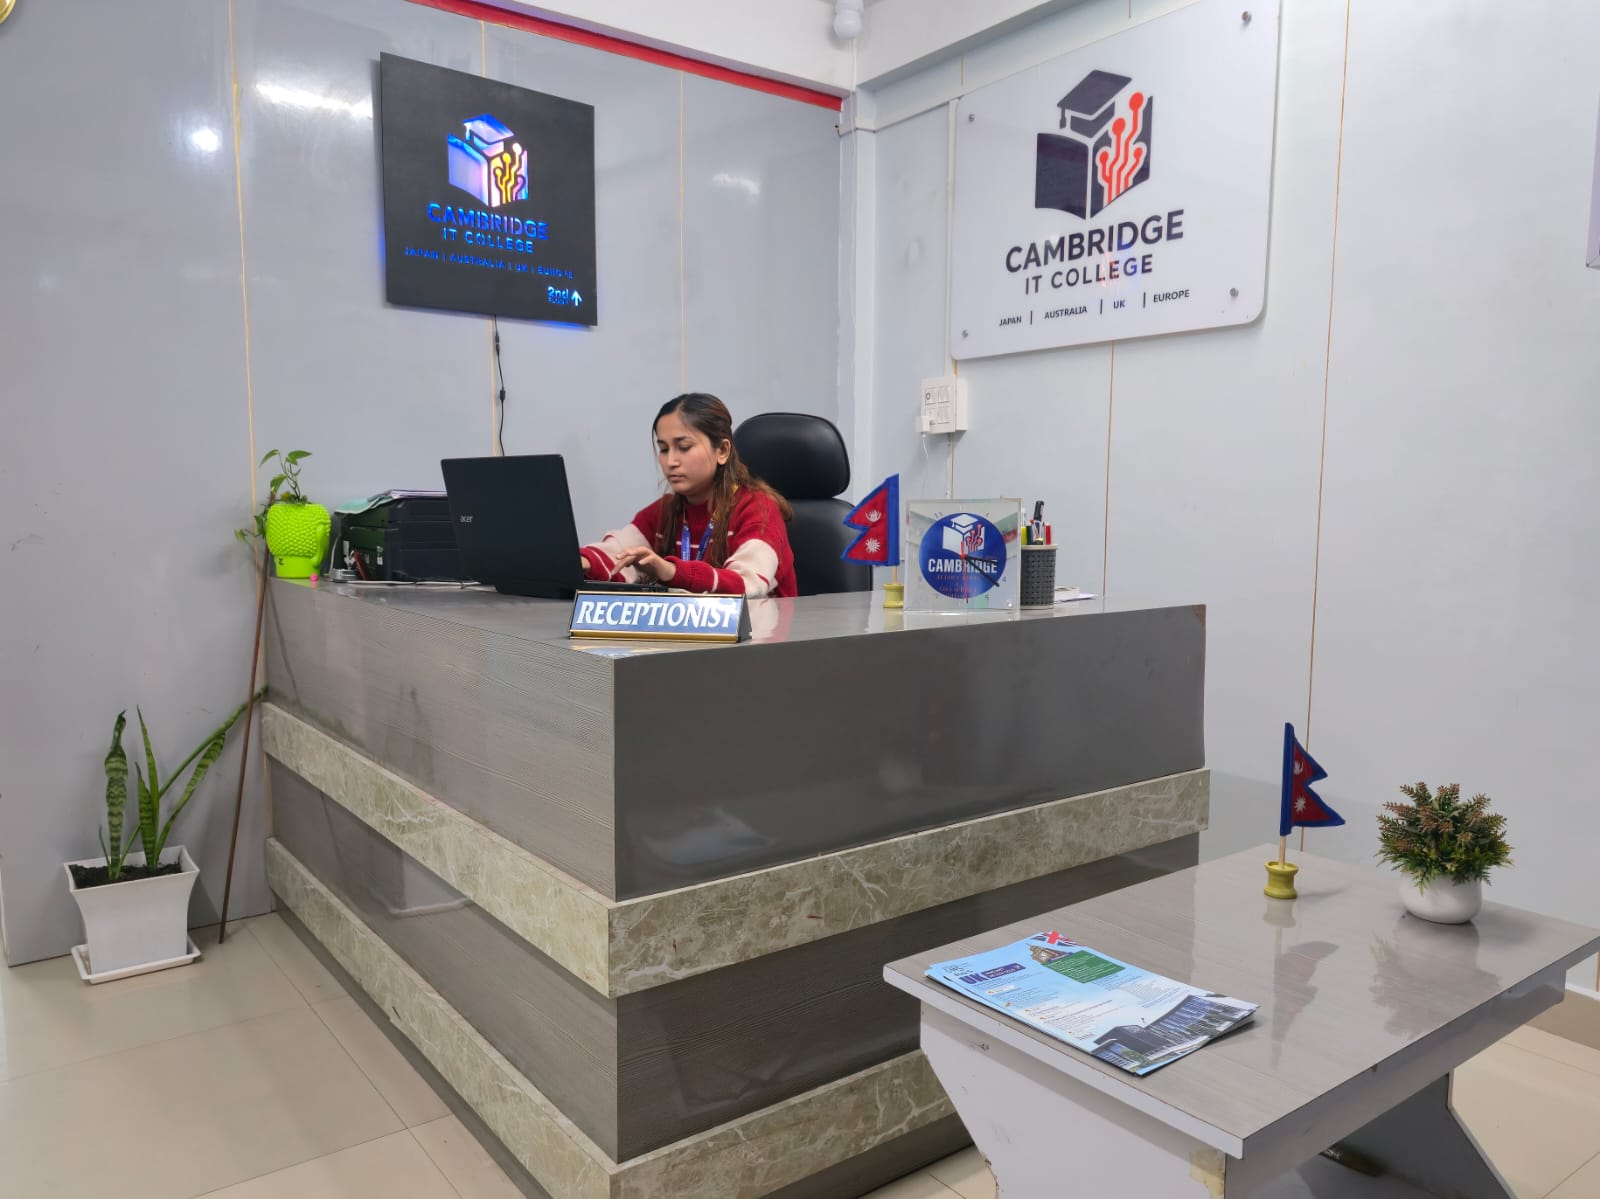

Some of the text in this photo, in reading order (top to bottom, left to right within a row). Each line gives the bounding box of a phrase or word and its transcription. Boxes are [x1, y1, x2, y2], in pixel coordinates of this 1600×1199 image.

[427, 203, 549, 240] CAMBRIDGE
[443, 227, 534, 253] IT COLLEGE
[1005, 209, 1184, 273] CAMBRIDGE
[1025, 254, 1153, 295] IT COLLEGE
[548, 286, 569, 300] 2nd
[999, 289, 1190, 327] JAPAN AUSTRALIA UK EUROPE
[576, 600, 737, 628] RECEPTIONIST
[959, 972, 989, 985] UK
